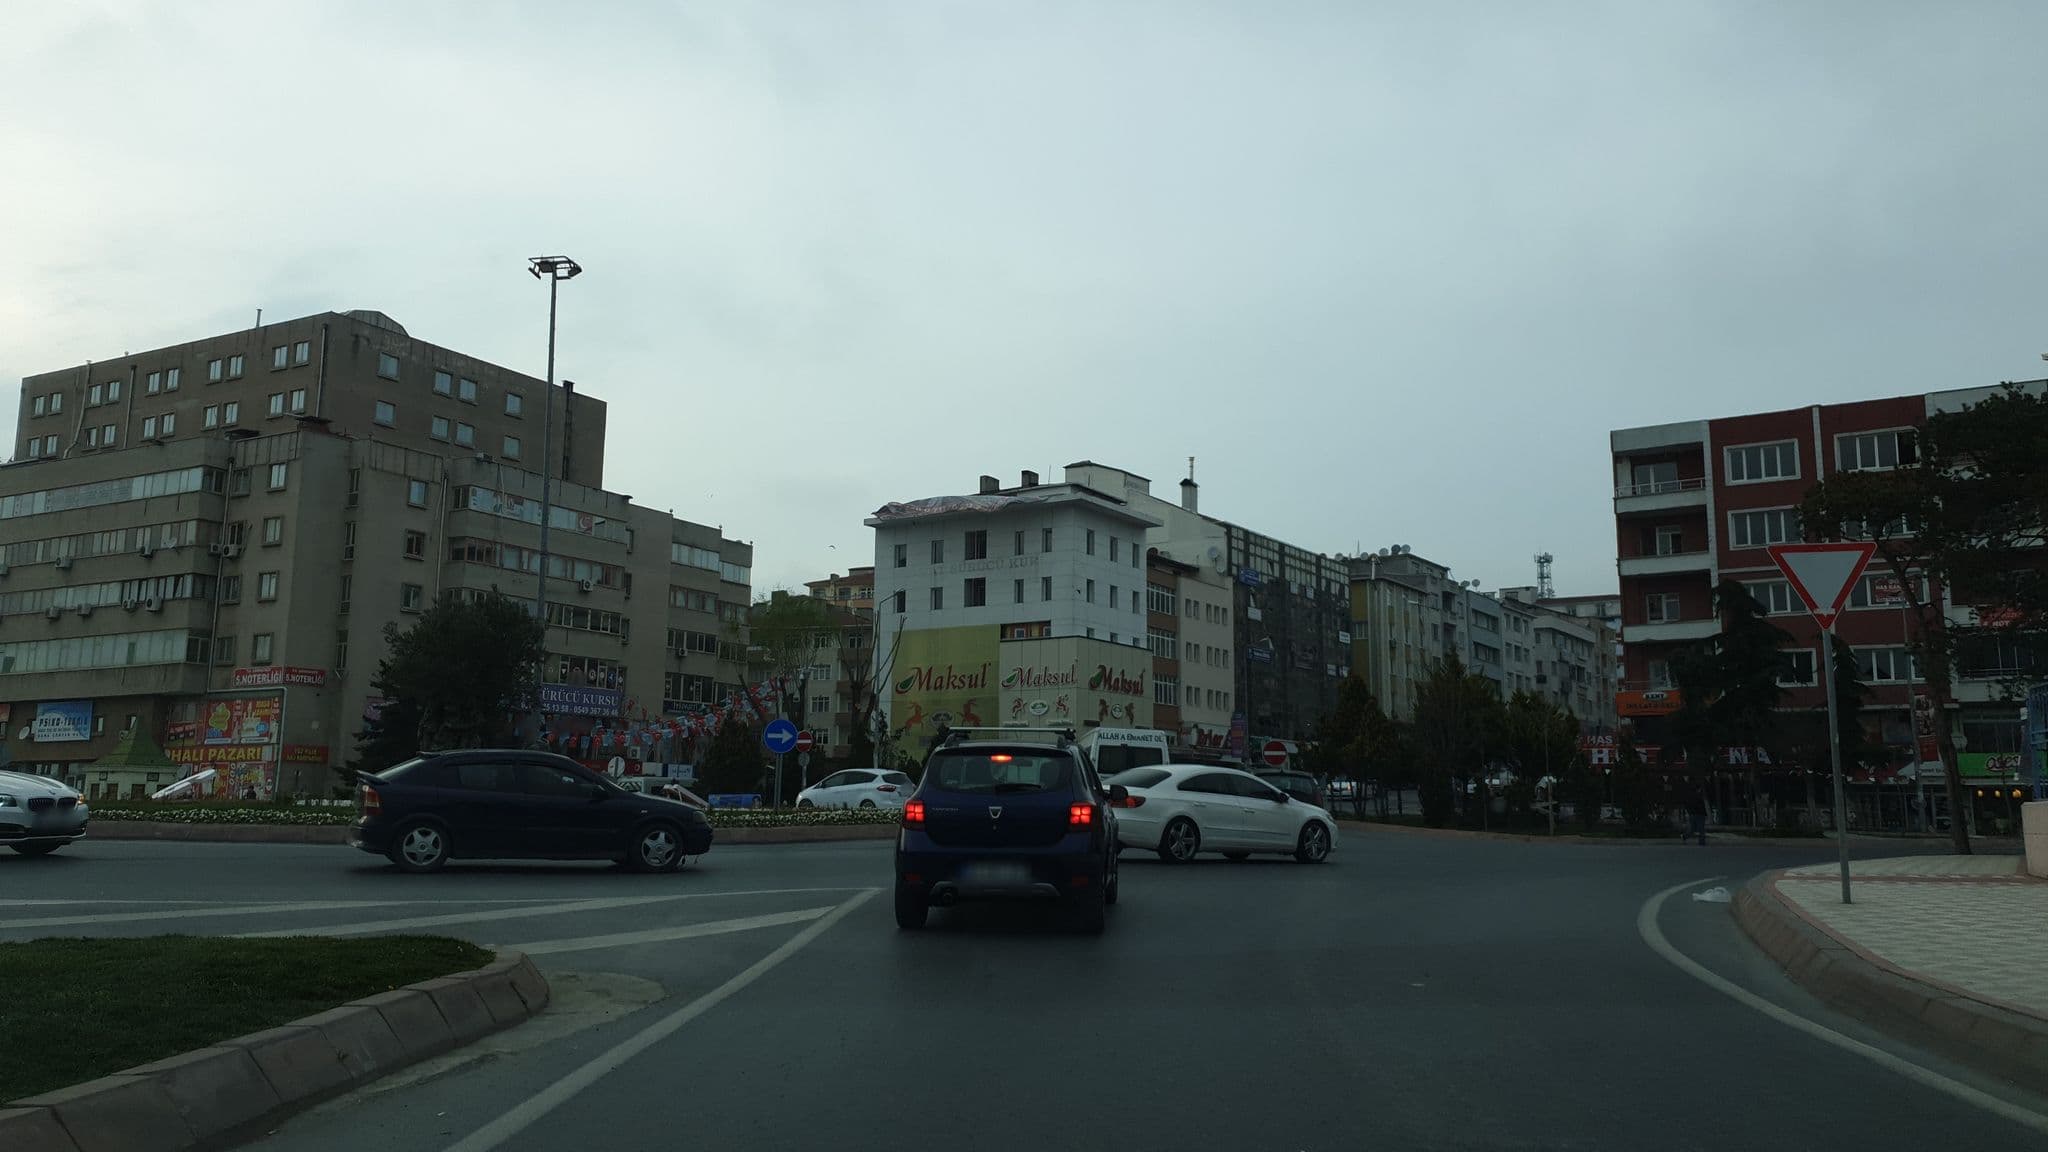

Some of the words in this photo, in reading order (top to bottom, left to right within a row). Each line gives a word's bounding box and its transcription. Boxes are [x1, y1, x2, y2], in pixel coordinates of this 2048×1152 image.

[896, 663, 988, 694] Maksul
[1002, 664, 1075, 688] Maksul
[1089, 665, 1145, 696] Maksul
[542, 688, 581, 703] ÜRÜCÜ
[583, 694, 619, 706] KURSU
[170, 748, 204, 762] HALI
[208, 746, 262, 761] PAZARI
